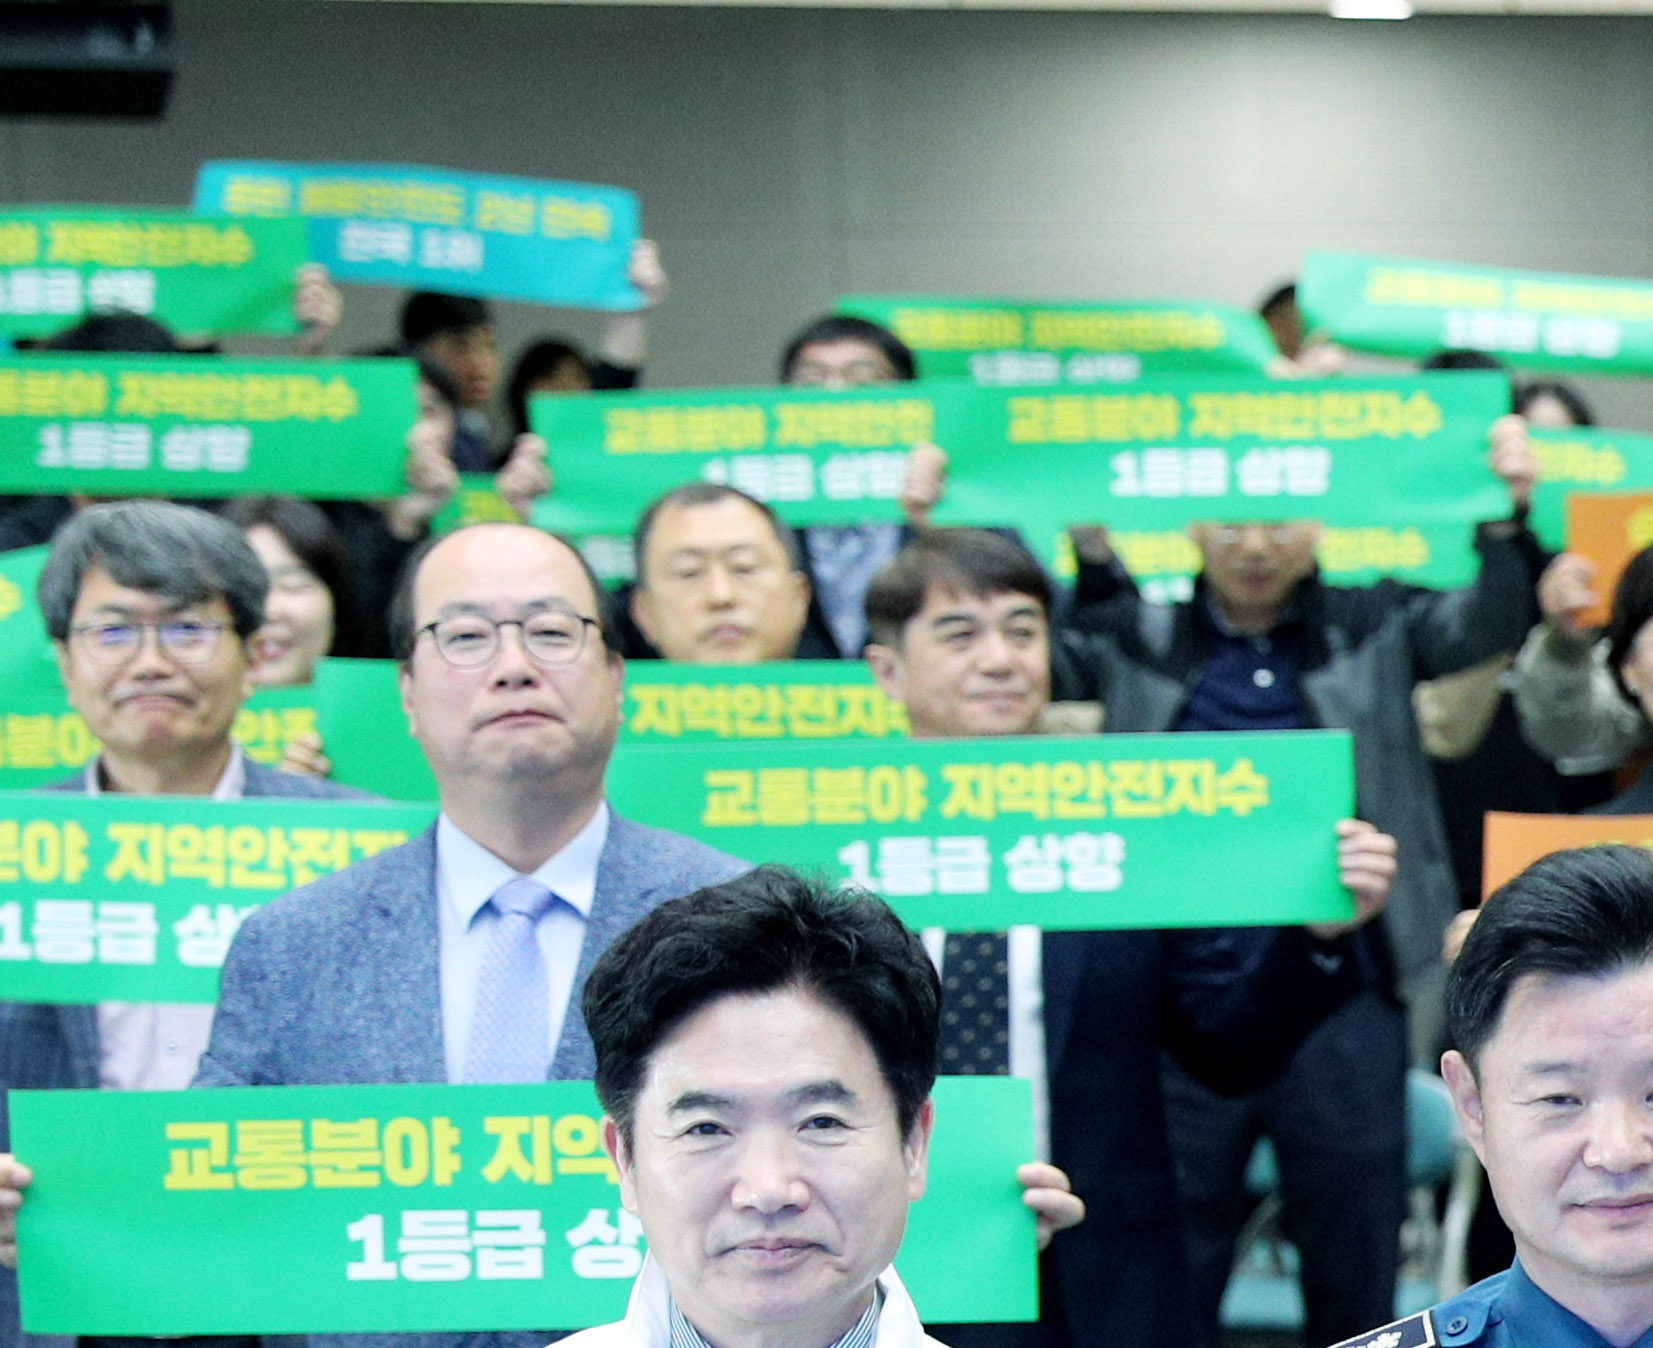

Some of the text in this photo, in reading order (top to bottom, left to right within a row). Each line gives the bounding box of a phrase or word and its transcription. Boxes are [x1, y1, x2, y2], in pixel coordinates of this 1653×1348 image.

[702, 757, 1270, 827] 교통분야 지역안전지수
[837, 831, 1126, 897] 1등급 상향
[164, 1116, 462, 1191] 교통분야
[346, 1208, 547, 1282] 1등급
